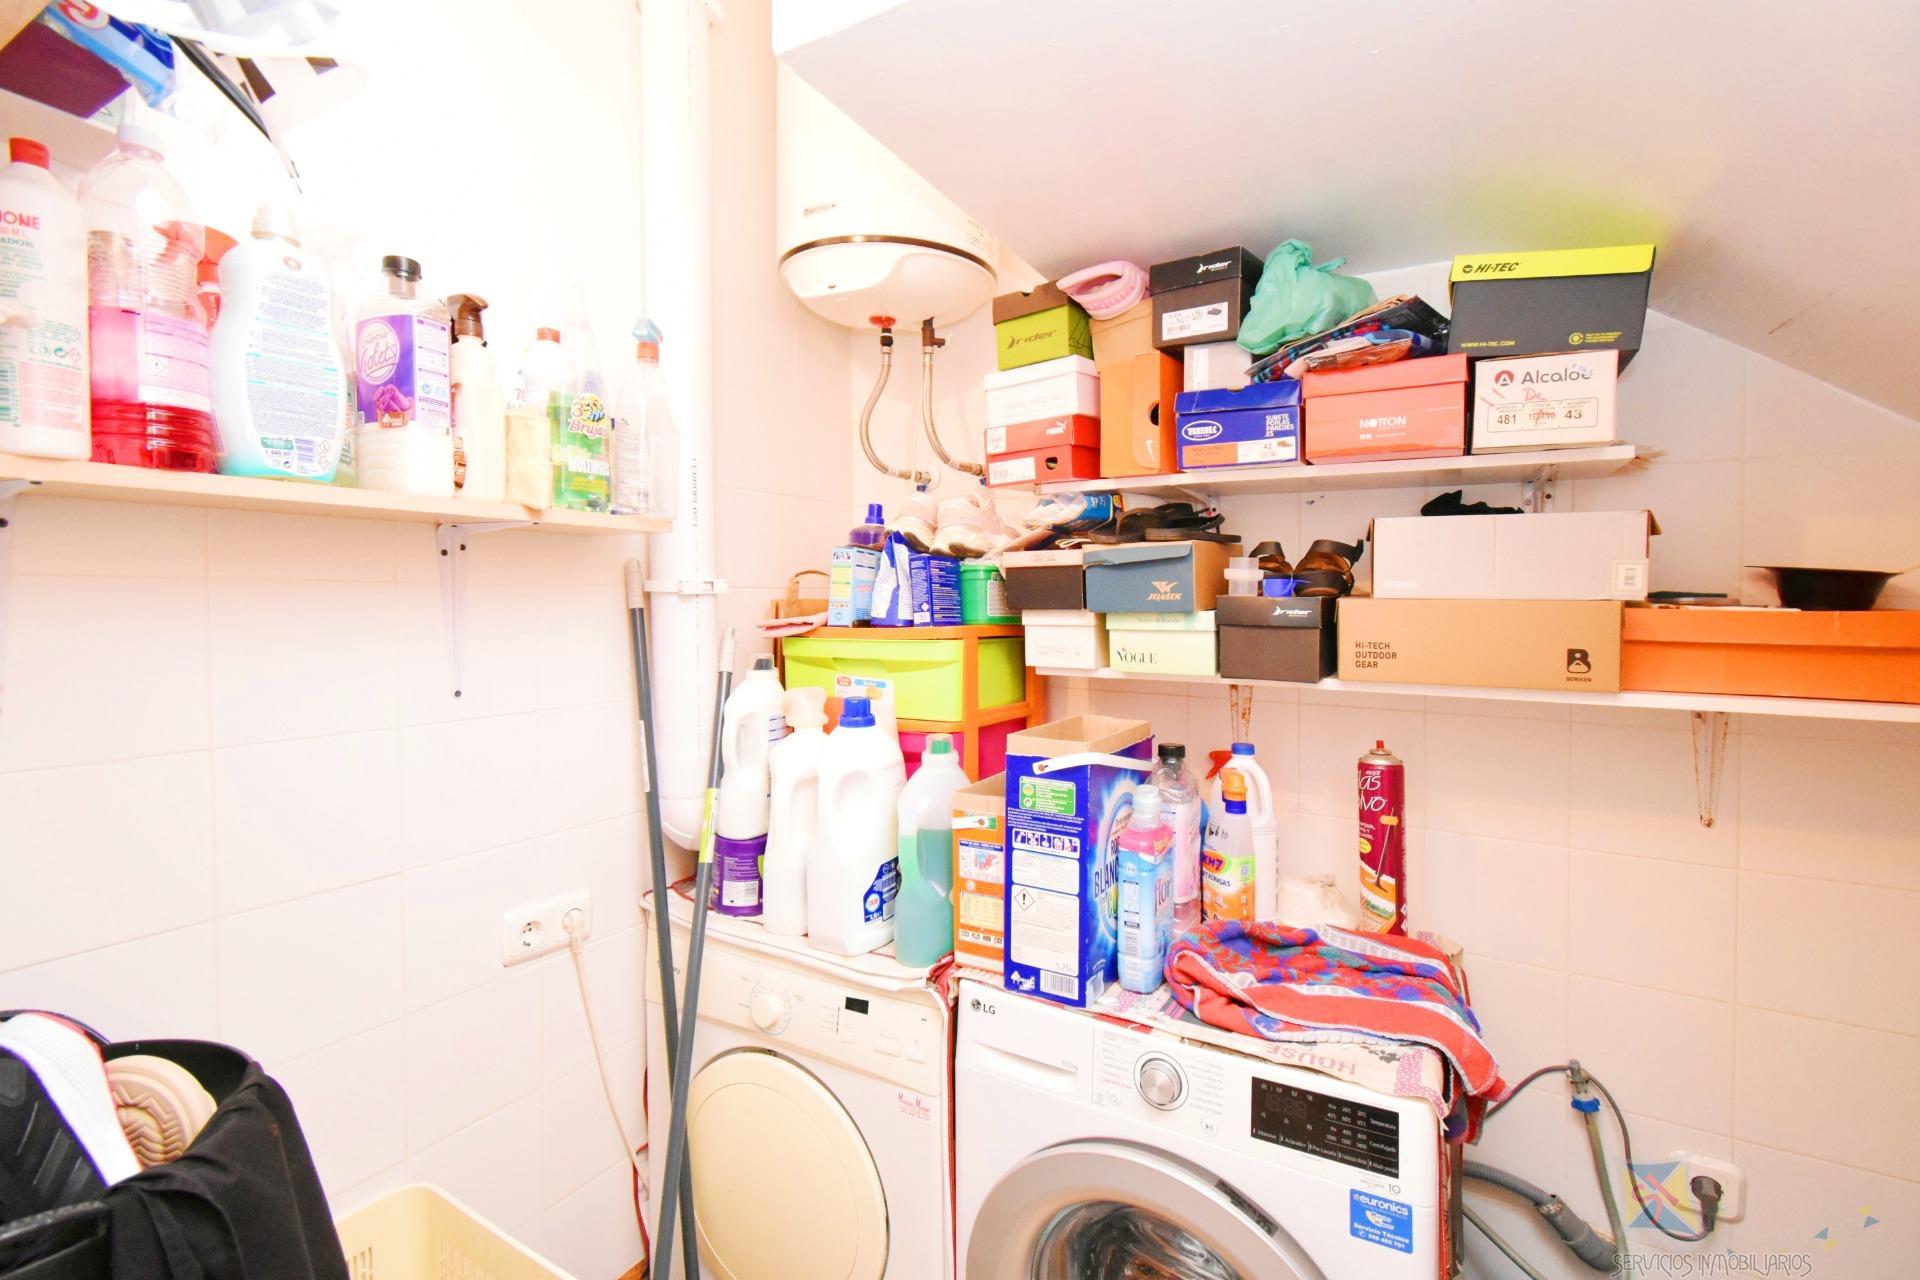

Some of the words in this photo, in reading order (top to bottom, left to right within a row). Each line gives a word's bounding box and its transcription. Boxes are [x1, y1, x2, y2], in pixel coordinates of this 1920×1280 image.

[1474, 262, 1519, 274] HI-TEC
[1496, 413, 1517, 425] 481
[1563, 409, 1583, 420] 43
[569, 420, 608, 438] Brujas
[1355, 641, 1391, 650] HI-TECH
[1116, 649, 1159, 665] VOGUE
[1355, 651, 1398, 660] OUTDOOR
[1355, 660, 1379, 669] GEAR
[982, 1003, 996, 1015] LG
[1358, 1194, 1409, 1217] euronics
